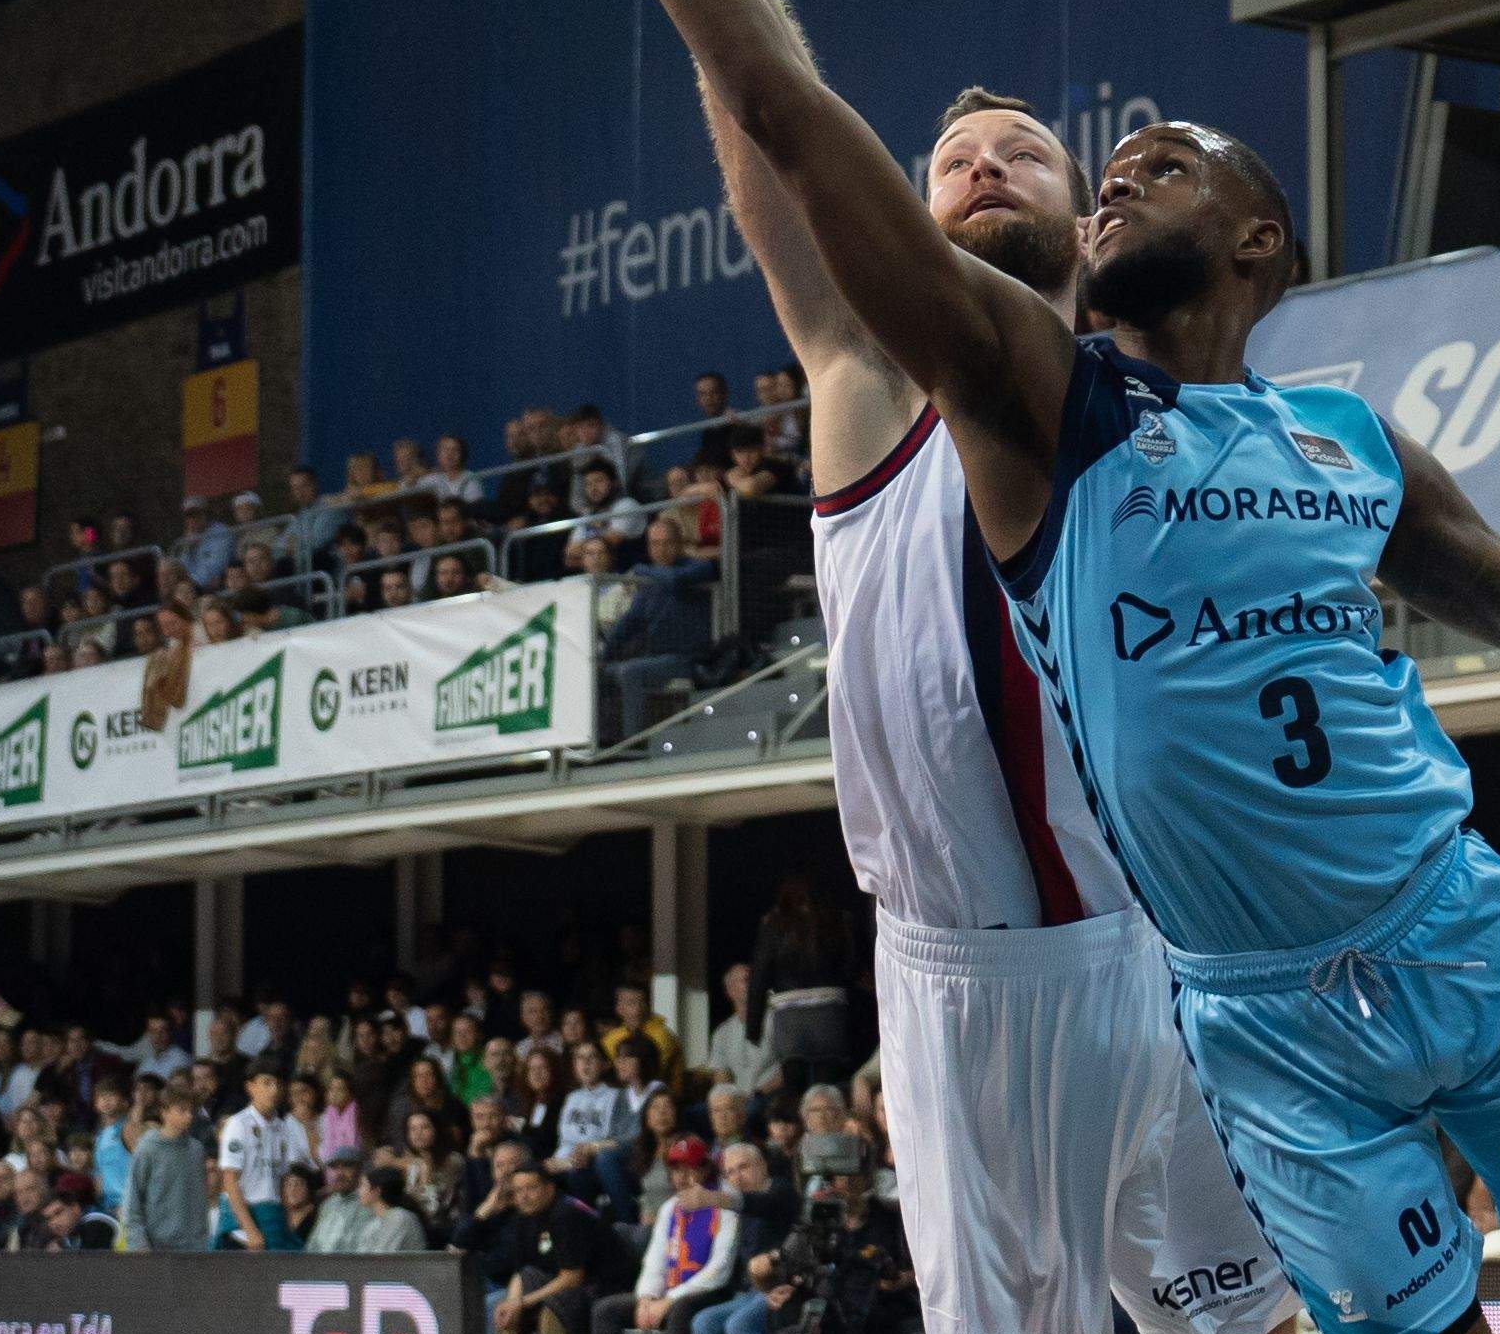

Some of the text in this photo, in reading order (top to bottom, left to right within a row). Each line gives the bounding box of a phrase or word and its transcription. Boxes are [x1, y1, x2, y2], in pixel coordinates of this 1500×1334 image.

[36, 123, 266, 266] Andorra
[80, 214, 268, 305] visitandorra.com
[1164, 487, 1393, 533] MORABANC
[1186, 592, 1380, 647] Andorr
[181, 676, 275, 765] FINISHER
[350, 660, 410, 697] KERN
[437, 630, 549, 728] FINISHER
[1258, 676, 1333, 788] 3
[1386, 1259, 1445, 1310] Andorra
